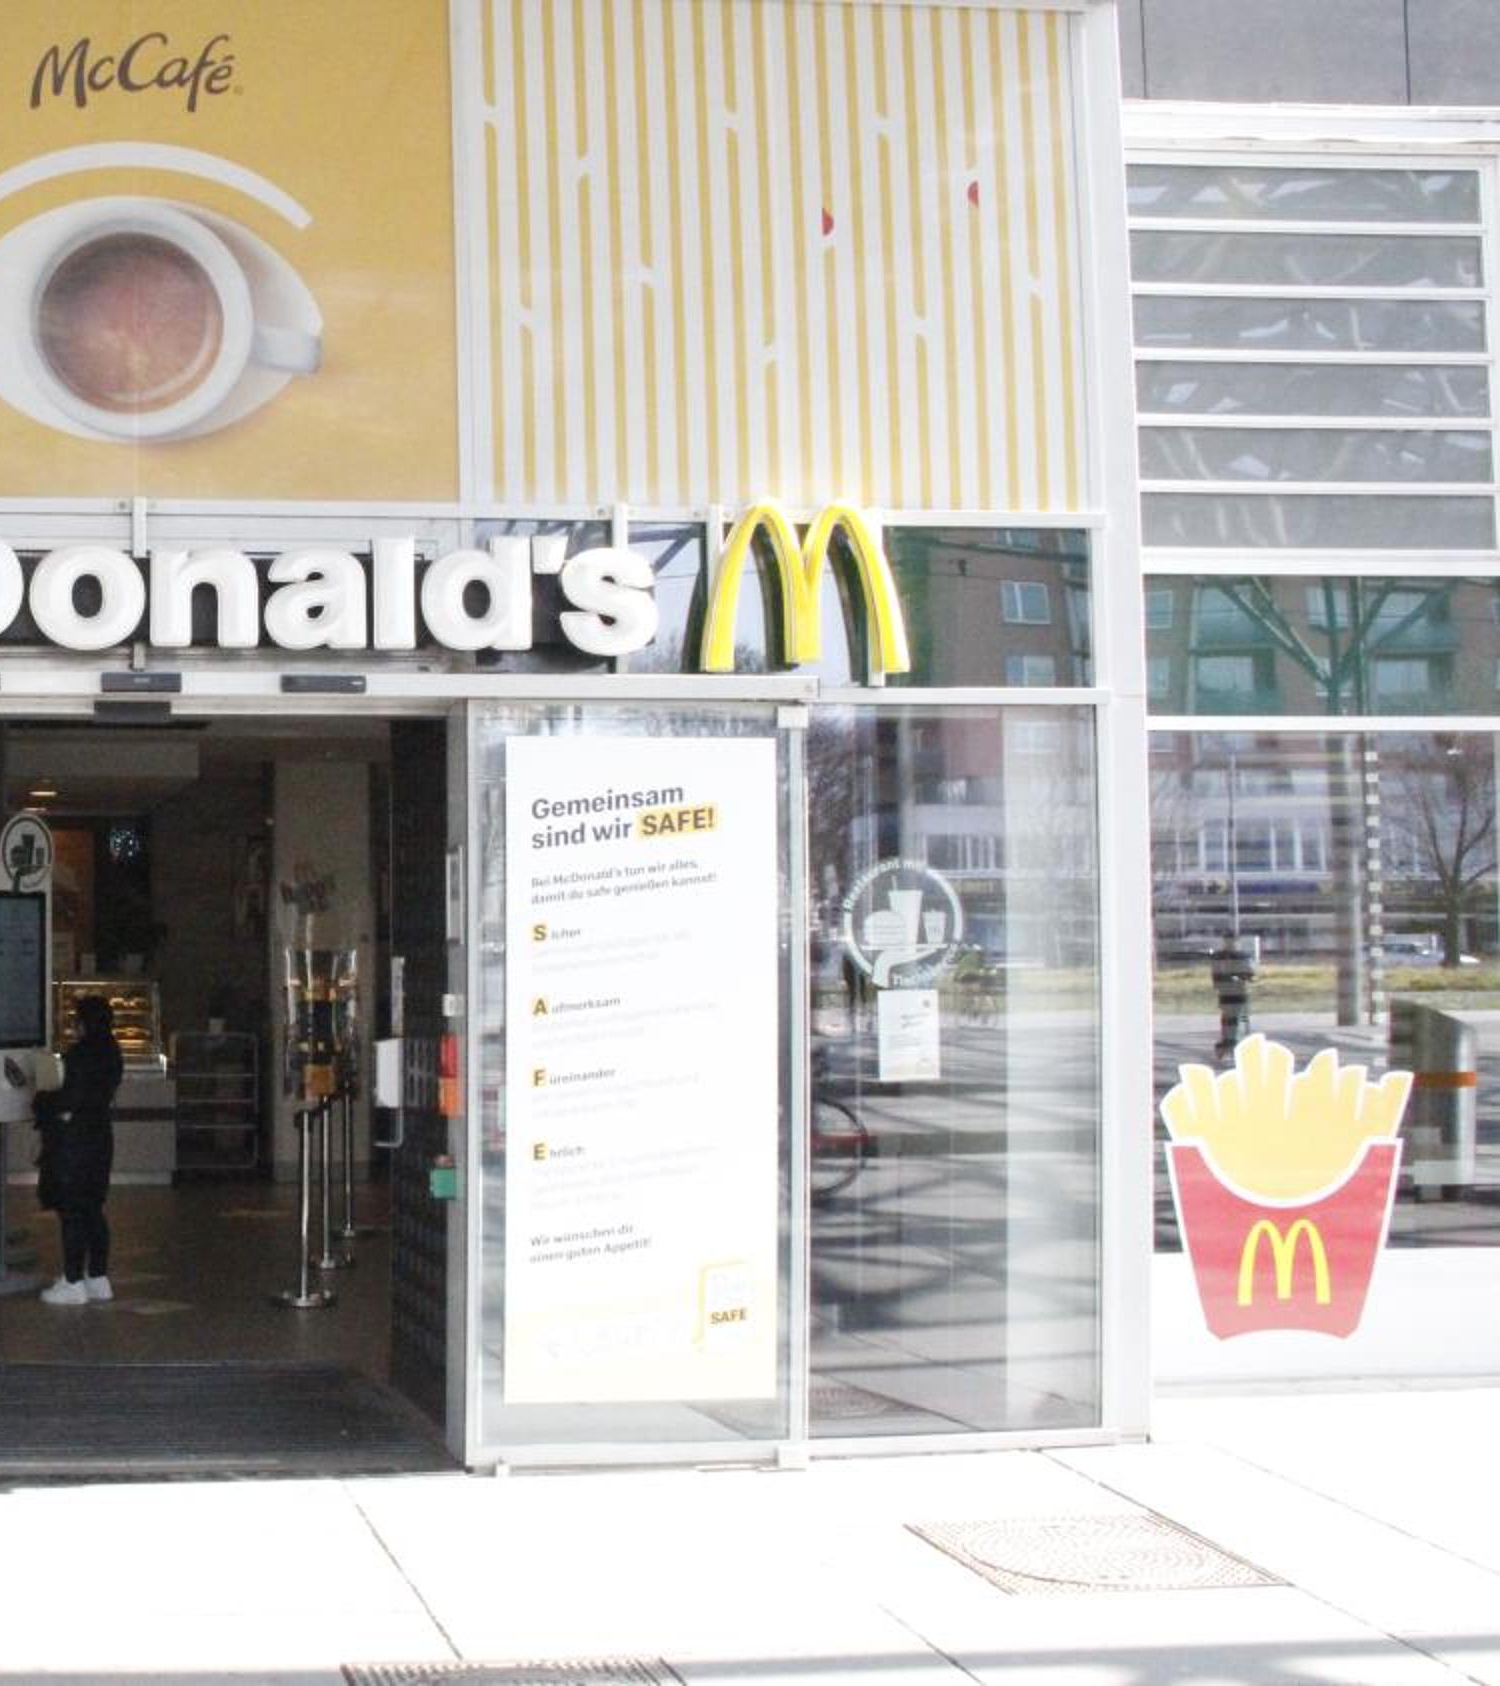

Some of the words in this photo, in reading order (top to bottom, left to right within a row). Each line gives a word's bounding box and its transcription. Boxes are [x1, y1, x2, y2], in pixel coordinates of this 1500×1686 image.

[29, 32, 236, 113] McCafé
[531, 786, 684, 820] Gemeinsam
[532, 823, 585, 850] sind
[591, 817, 632, 842] wir
[642, 807, 714, 837] SAFE!
[552, 868, 622, 887] McDonald's
[710, 1307, 748, 1324] SAFE
